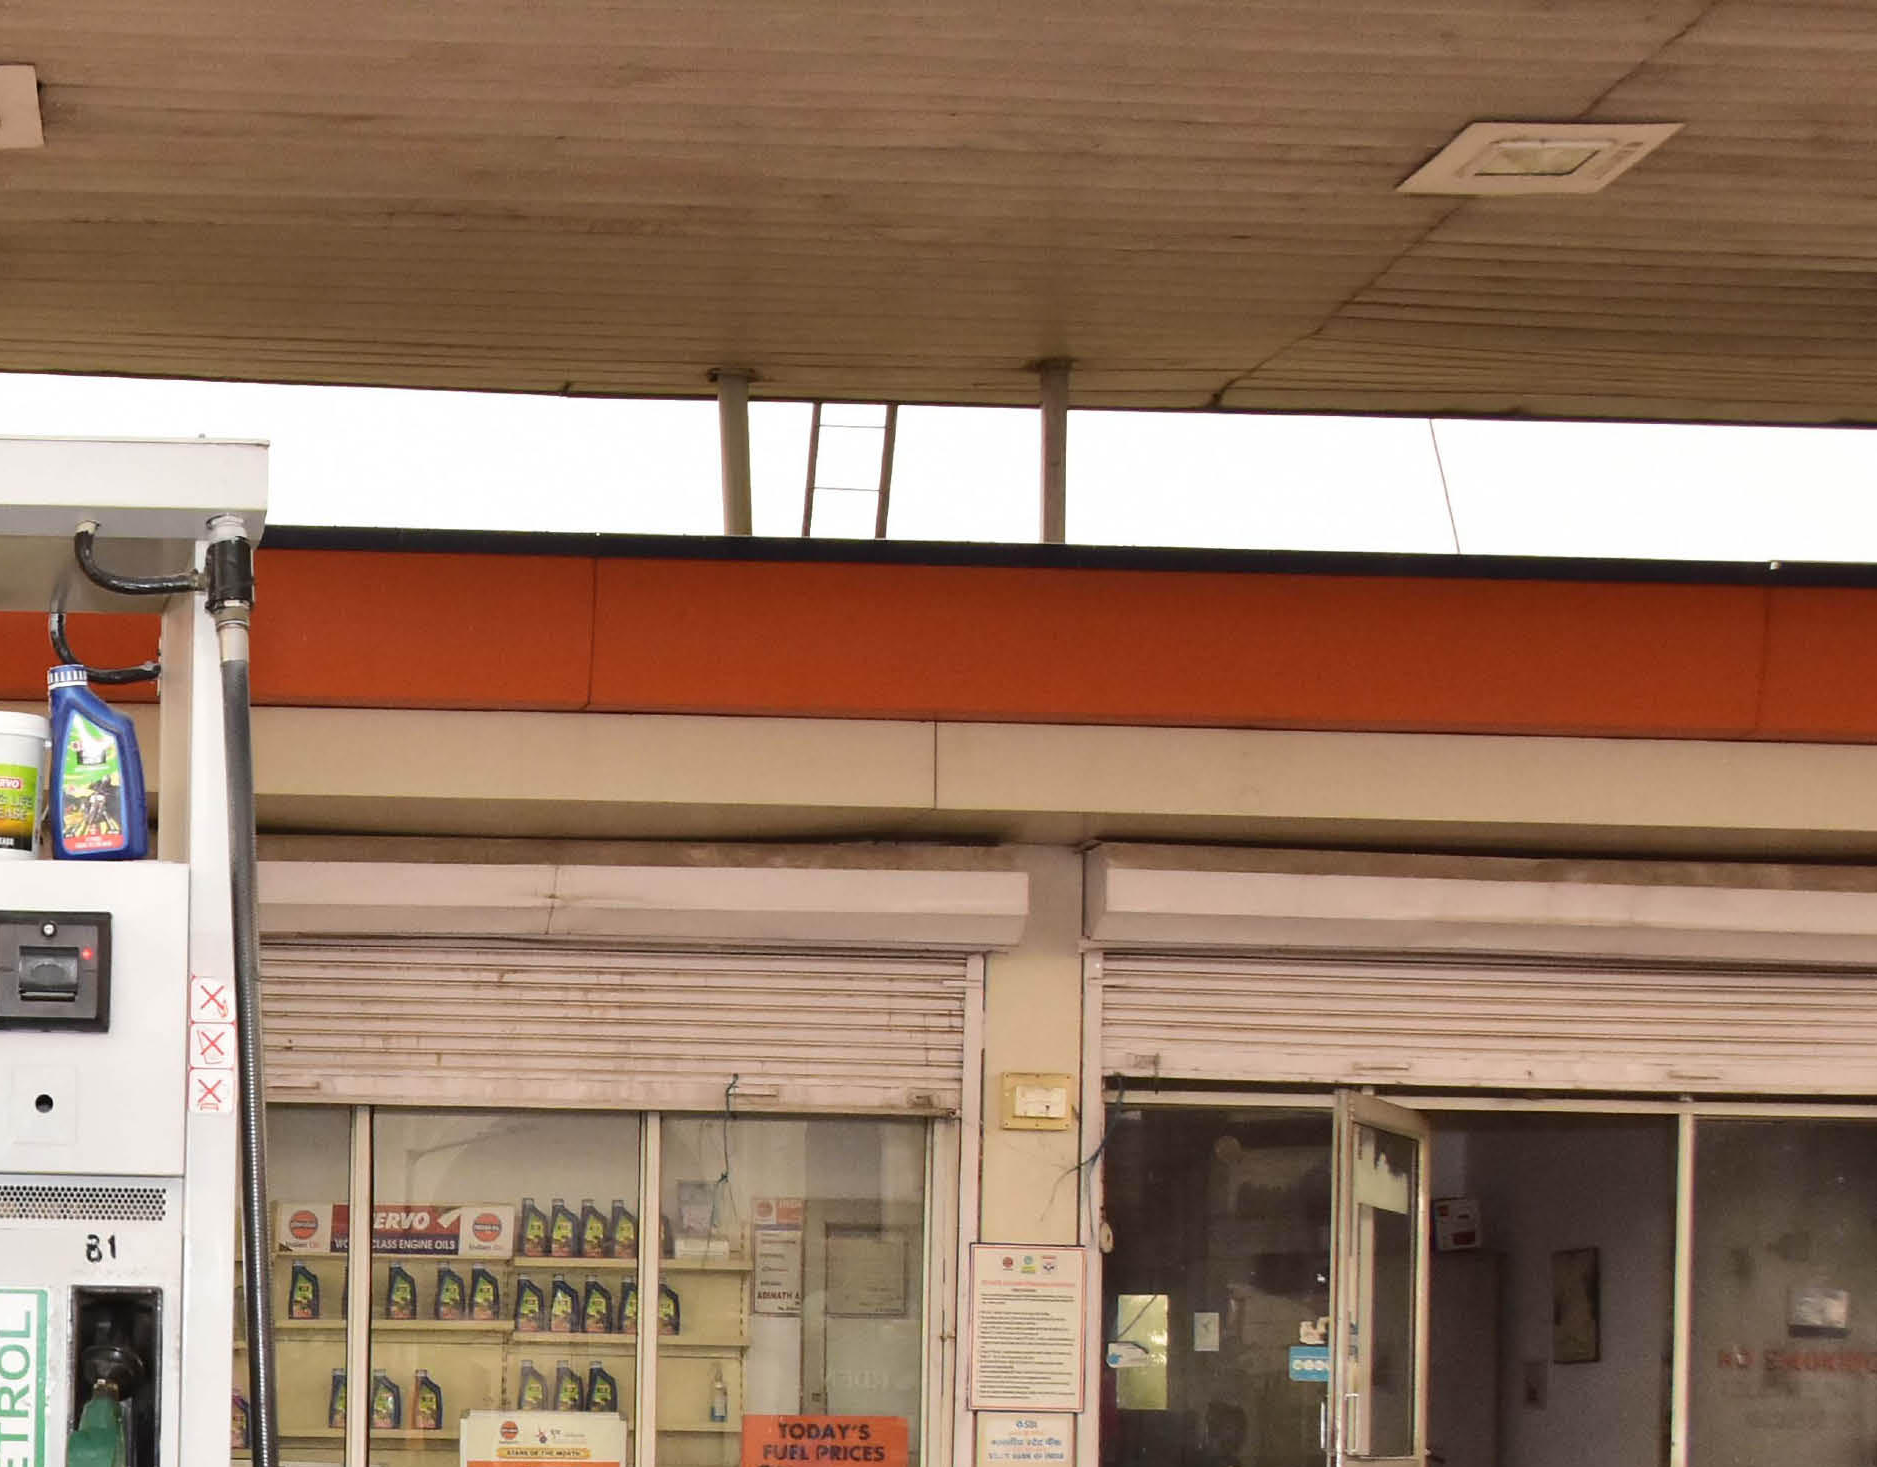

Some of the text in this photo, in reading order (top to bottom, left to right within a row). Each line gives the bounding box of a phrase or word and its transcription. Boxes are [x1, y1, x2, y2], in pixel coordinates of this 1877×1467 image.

[373, 1211, 430, 1230] ERVO
[399, 1239, 432, 1250] ENGINE
[435, 1240, 455, 1251] OILS
[778, 1422, 871, 1441] TODAY'S
[763, 1444, 885, 1462] FUEL PRICES
